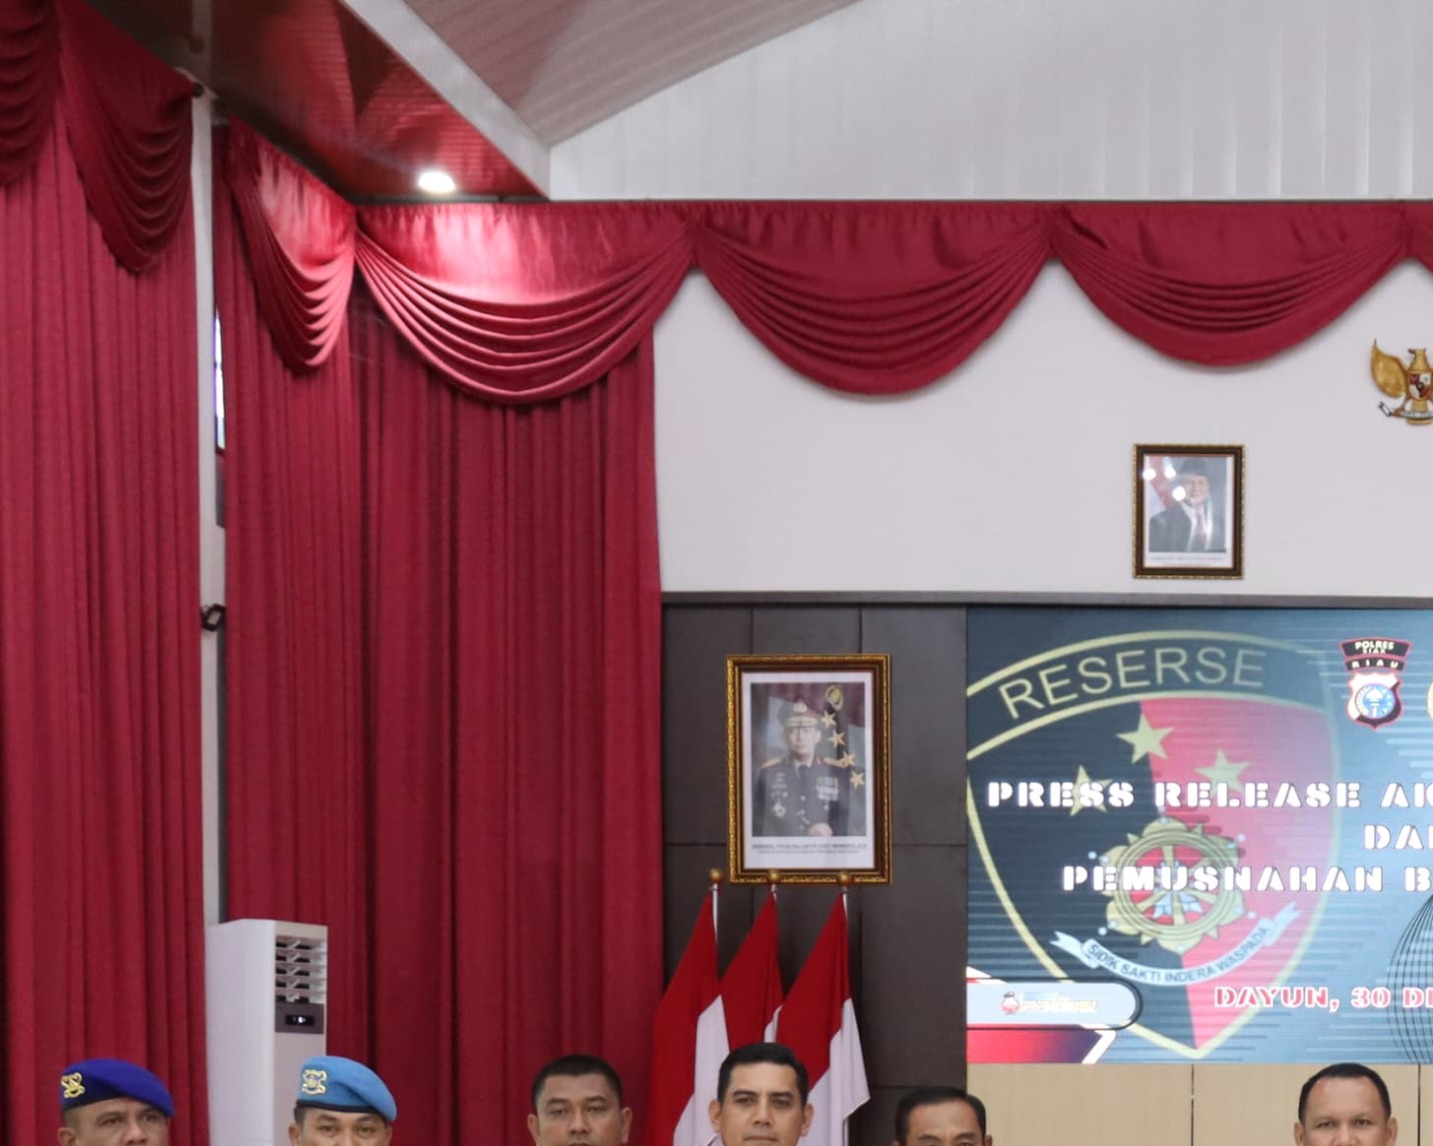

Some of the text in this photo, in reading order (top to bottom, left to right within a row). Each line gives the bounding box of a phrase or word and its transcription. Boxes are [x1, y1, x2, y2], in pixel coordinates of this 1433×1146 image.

[998, 645, 1267, 720] RESERSE
[986, 781, 1135, 809] PRESS
[1154, 781, 1361, 809] RELEASE
[1061, 865, 1384, 893] PEMUSNAHAN
[1214, 985, 1341, 1012] DAYUN,
[1350, 985, 1391, 1009] 30
